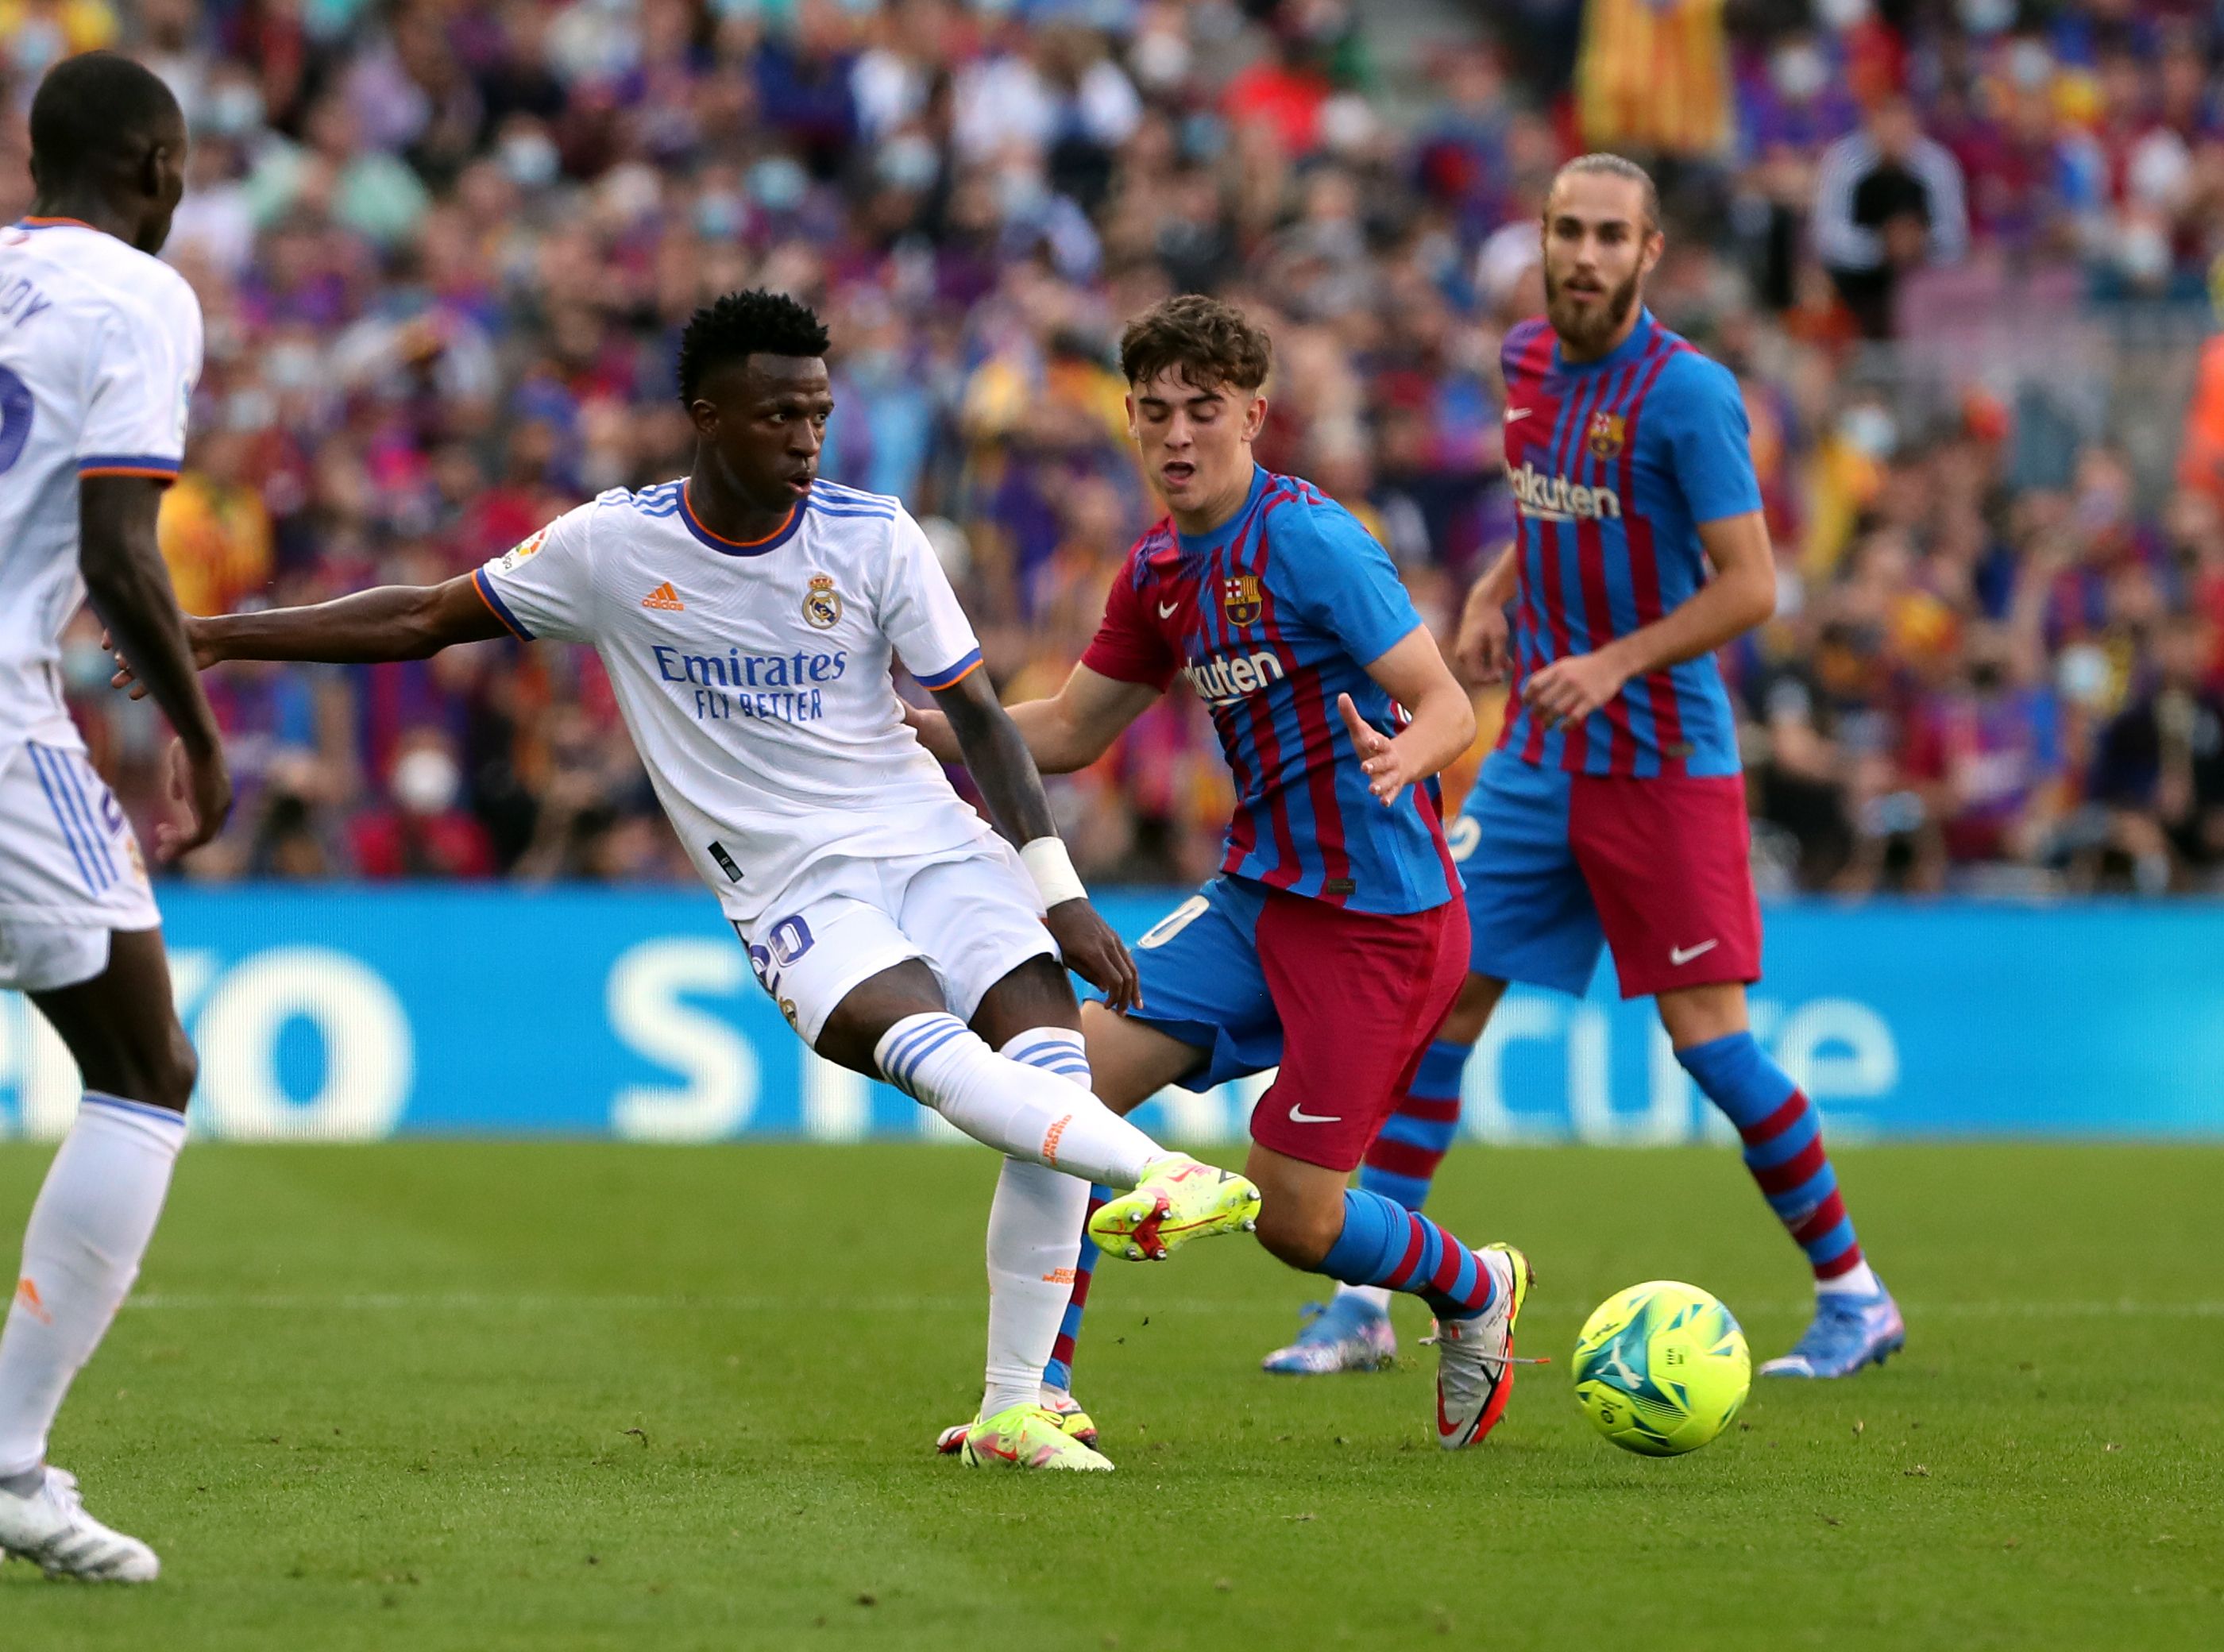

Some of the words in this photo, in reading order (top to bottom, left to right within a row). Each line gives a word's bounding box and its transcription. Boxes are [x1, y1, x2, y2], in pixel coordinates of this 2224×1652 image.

[1508, 461, 1621, 519] akuten
[642, 598, 685, 612] adidas
[651, 644, 848, 687] Emirates
[1183, 650, 1285, 699] kuten
[695, 689, 730, 720] FLY
[739, 688, 823, 723] BETTER
